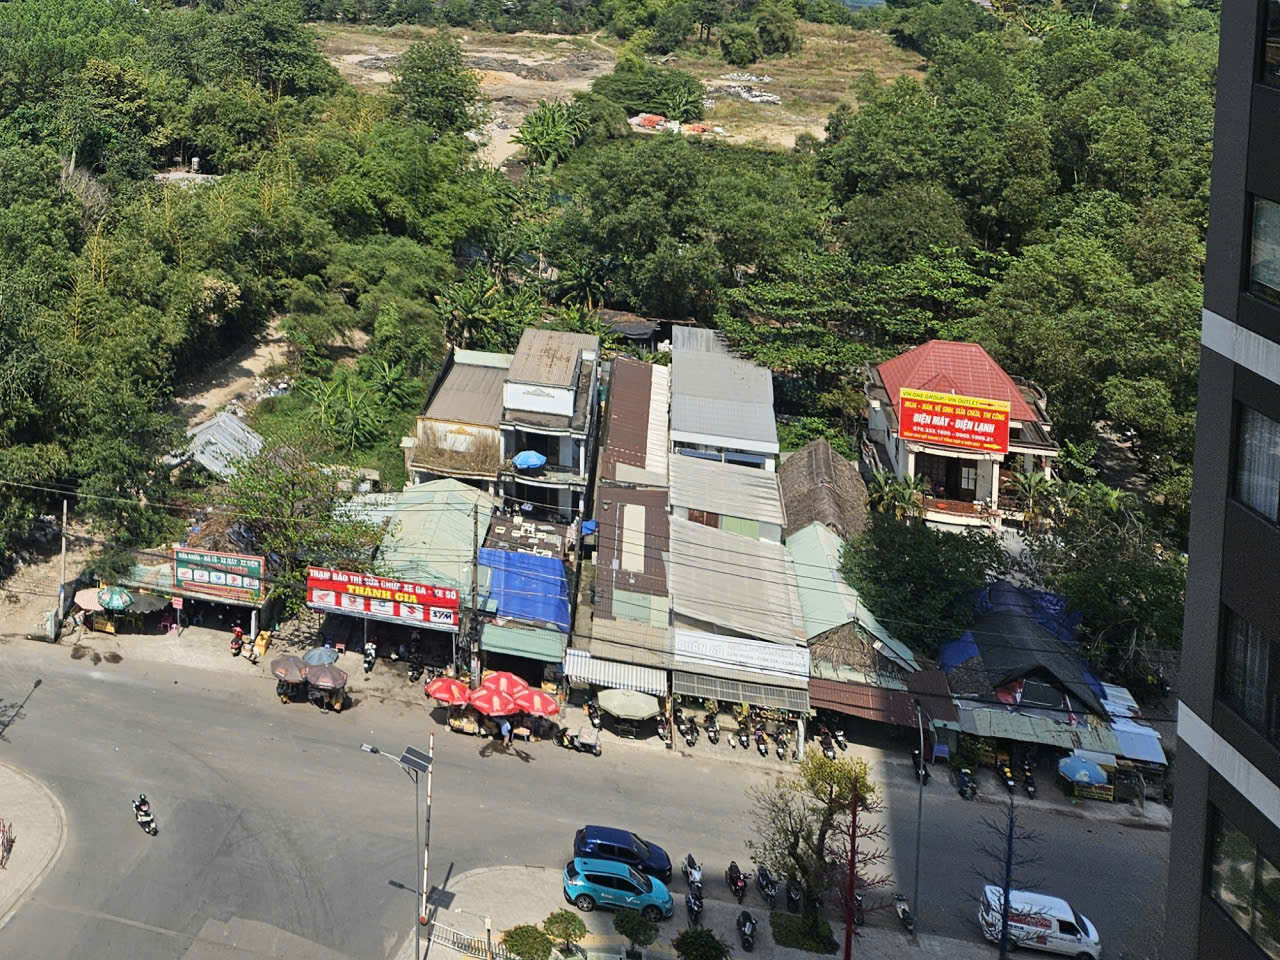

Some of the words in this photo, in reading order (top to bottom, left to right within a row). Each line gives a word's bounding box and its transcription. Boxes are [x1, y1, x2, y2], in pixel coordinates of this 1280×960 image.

[924, 393, 944, 401] GROUP
[932, 415, 950, 427] MÁY
[974, 422, 995, 433] LẠNH
[309, 569, 331, 581] TRẠM
[403, 583, 415, 593] XE
[415, 585, 427, 595] GA
[432, 588, 444, 598] XE
[394, 591, 418, 603] GIA
[432, 610, 452, 620] SYM
